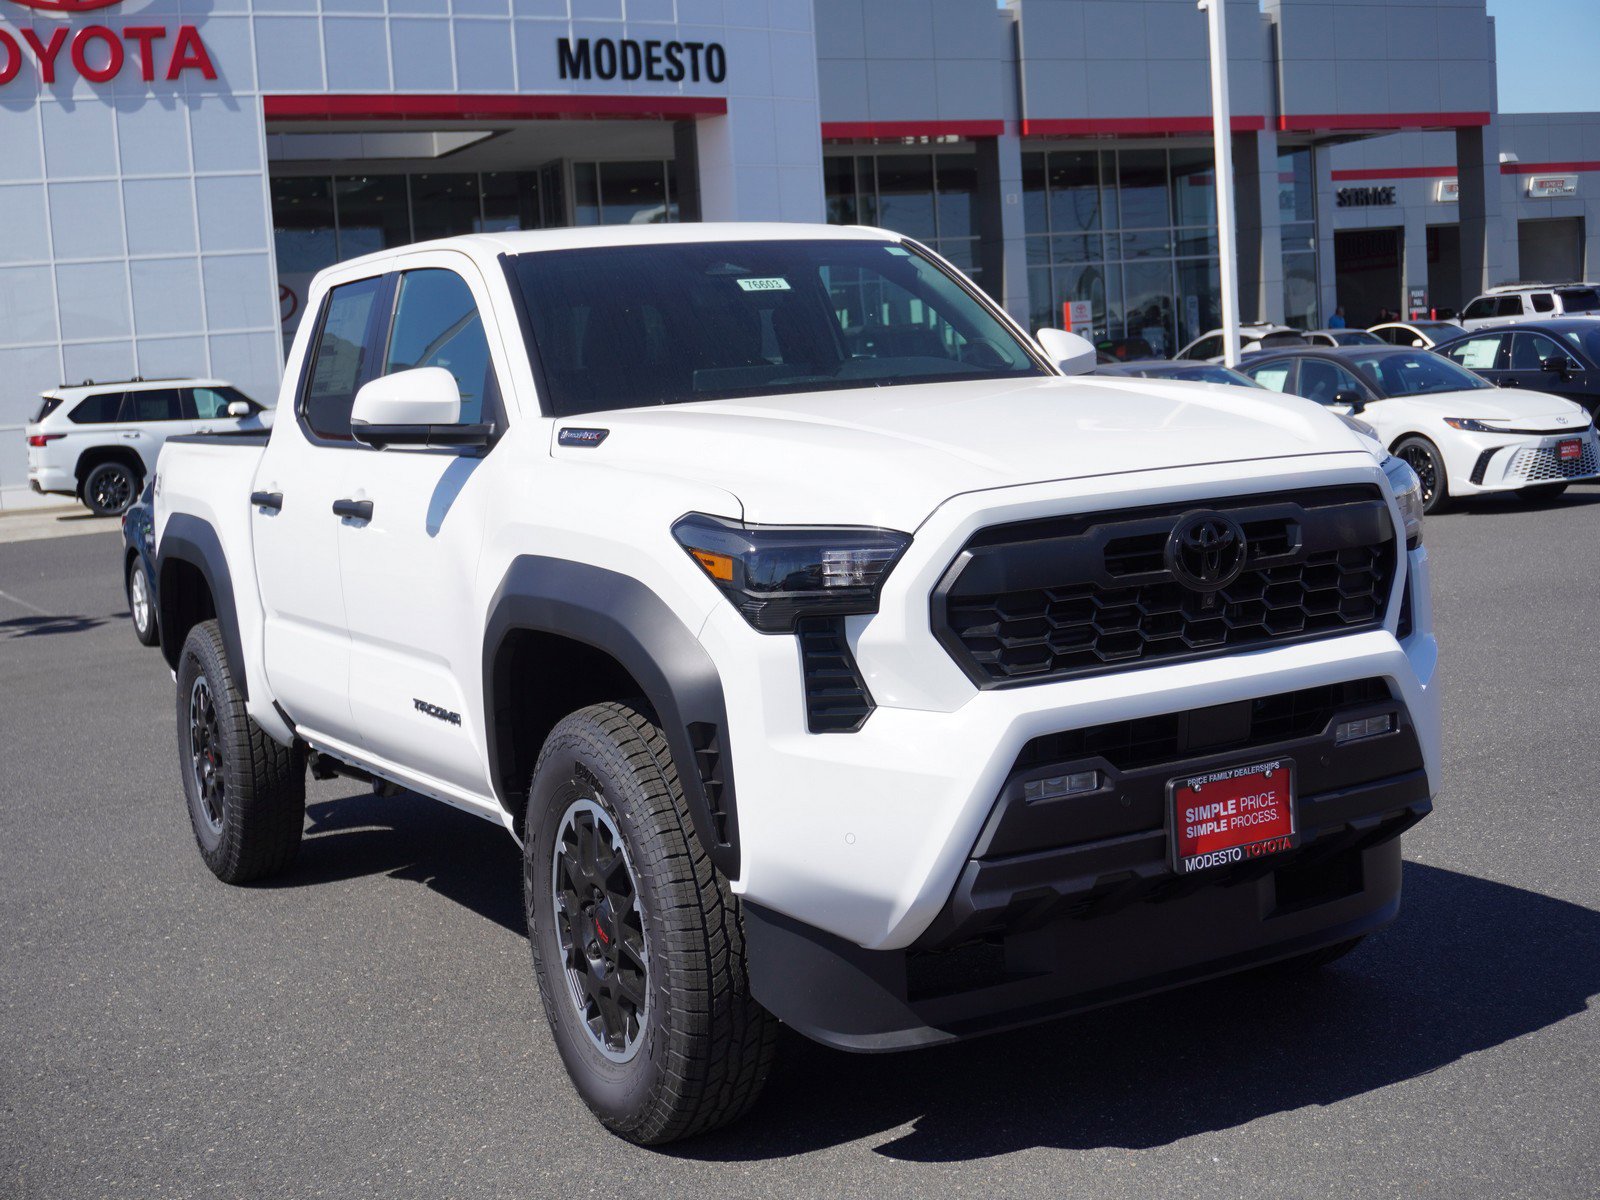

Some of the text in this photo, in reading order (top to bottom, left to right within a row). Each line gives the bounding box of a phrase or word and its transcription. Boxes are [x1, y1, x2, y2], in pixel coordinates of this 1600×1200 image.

[556, 37, 727, 84] MODESTO
[1336, 186, 1396, 207] SERVICE
[744, 279, 783, 289] 76603
[412, 698, 462, 727] TACOMA
[1187, 761, 1280, 787] PRICE FAMILY DEALERSHIPS
[1185, 791, 1279, 823] SIMPLE PRICE.
[1186, 808, 1280, 839] SIMPLE PROCESS.
[1185, 837, 1292, 873] MODESTO TOYOTA
